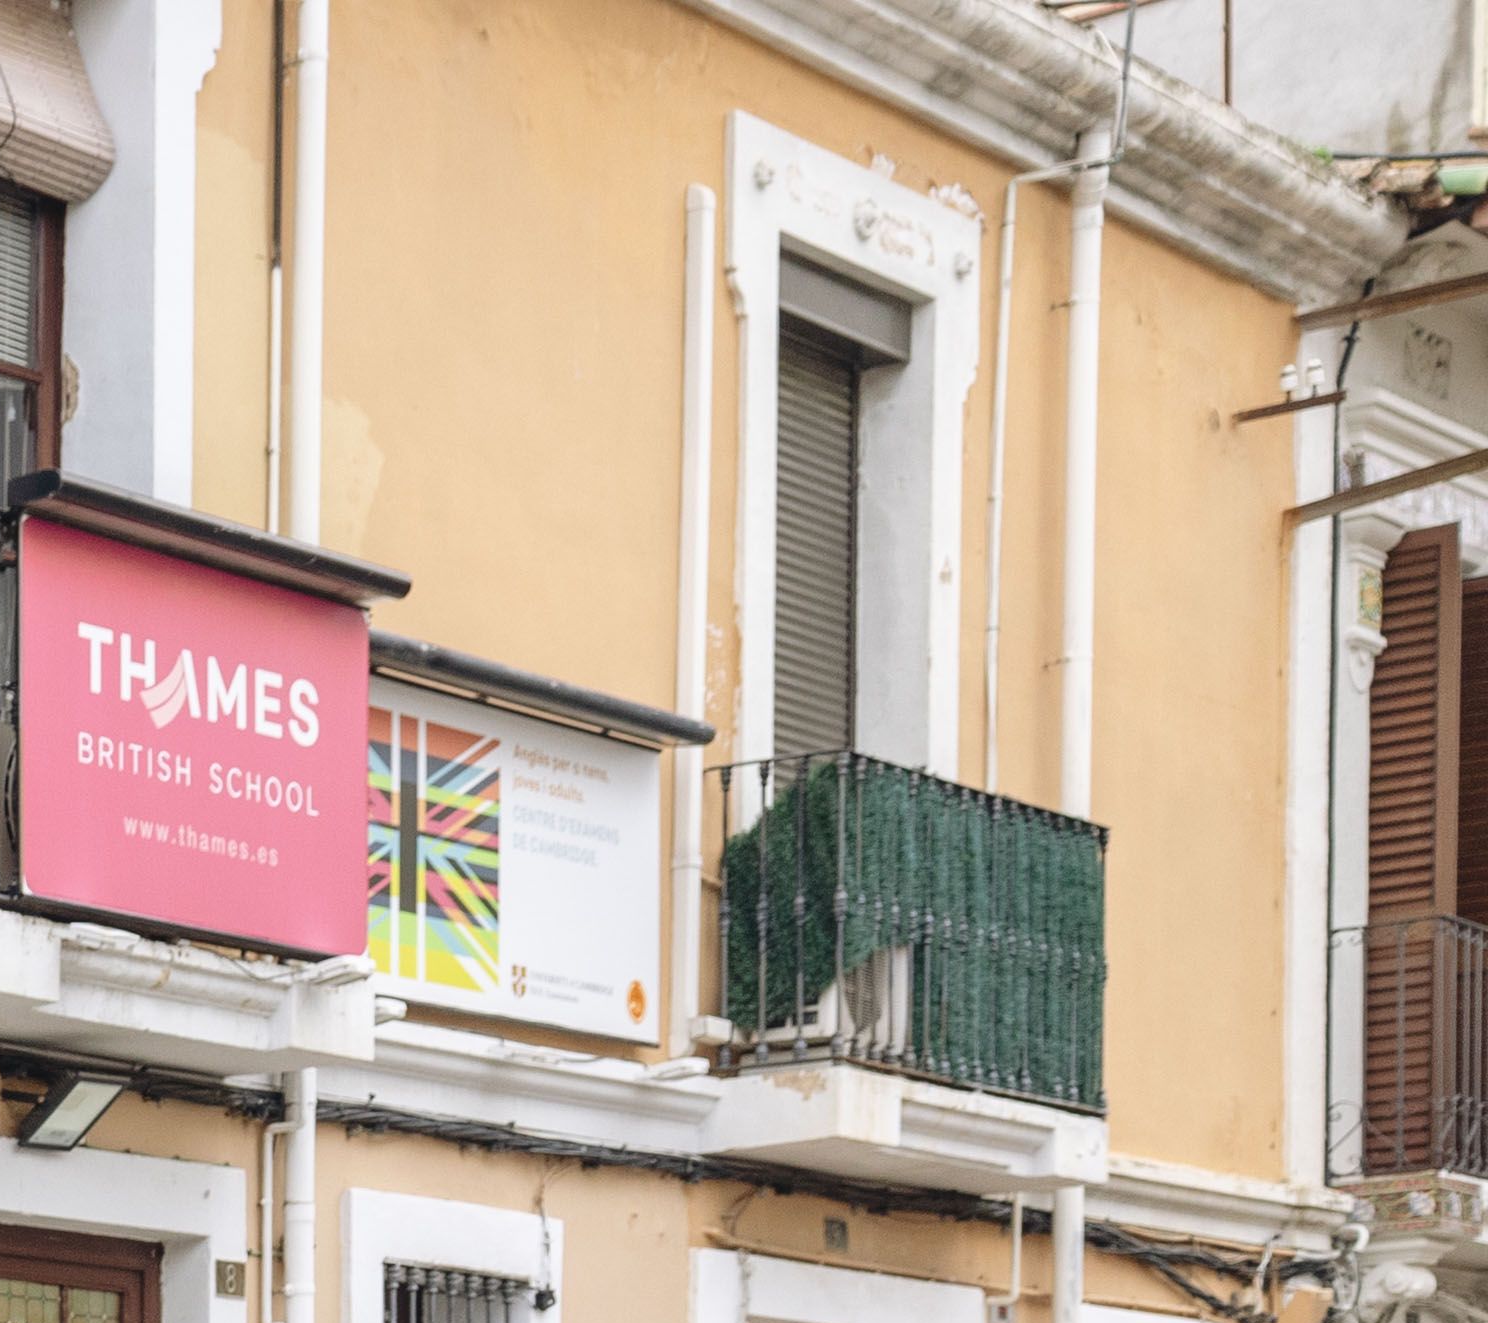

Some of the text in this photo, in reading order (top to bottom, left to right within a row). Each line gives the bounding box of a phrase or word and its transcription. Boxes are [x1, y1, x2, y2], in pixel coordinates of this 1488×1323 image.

[77, 621, 320, 748] THAMES
[77, 731, 320, 817] BRITISH SCHOOL
[124, 815, 279, 867] www.thames.es
[225, 1264, 236, 1293] 8
